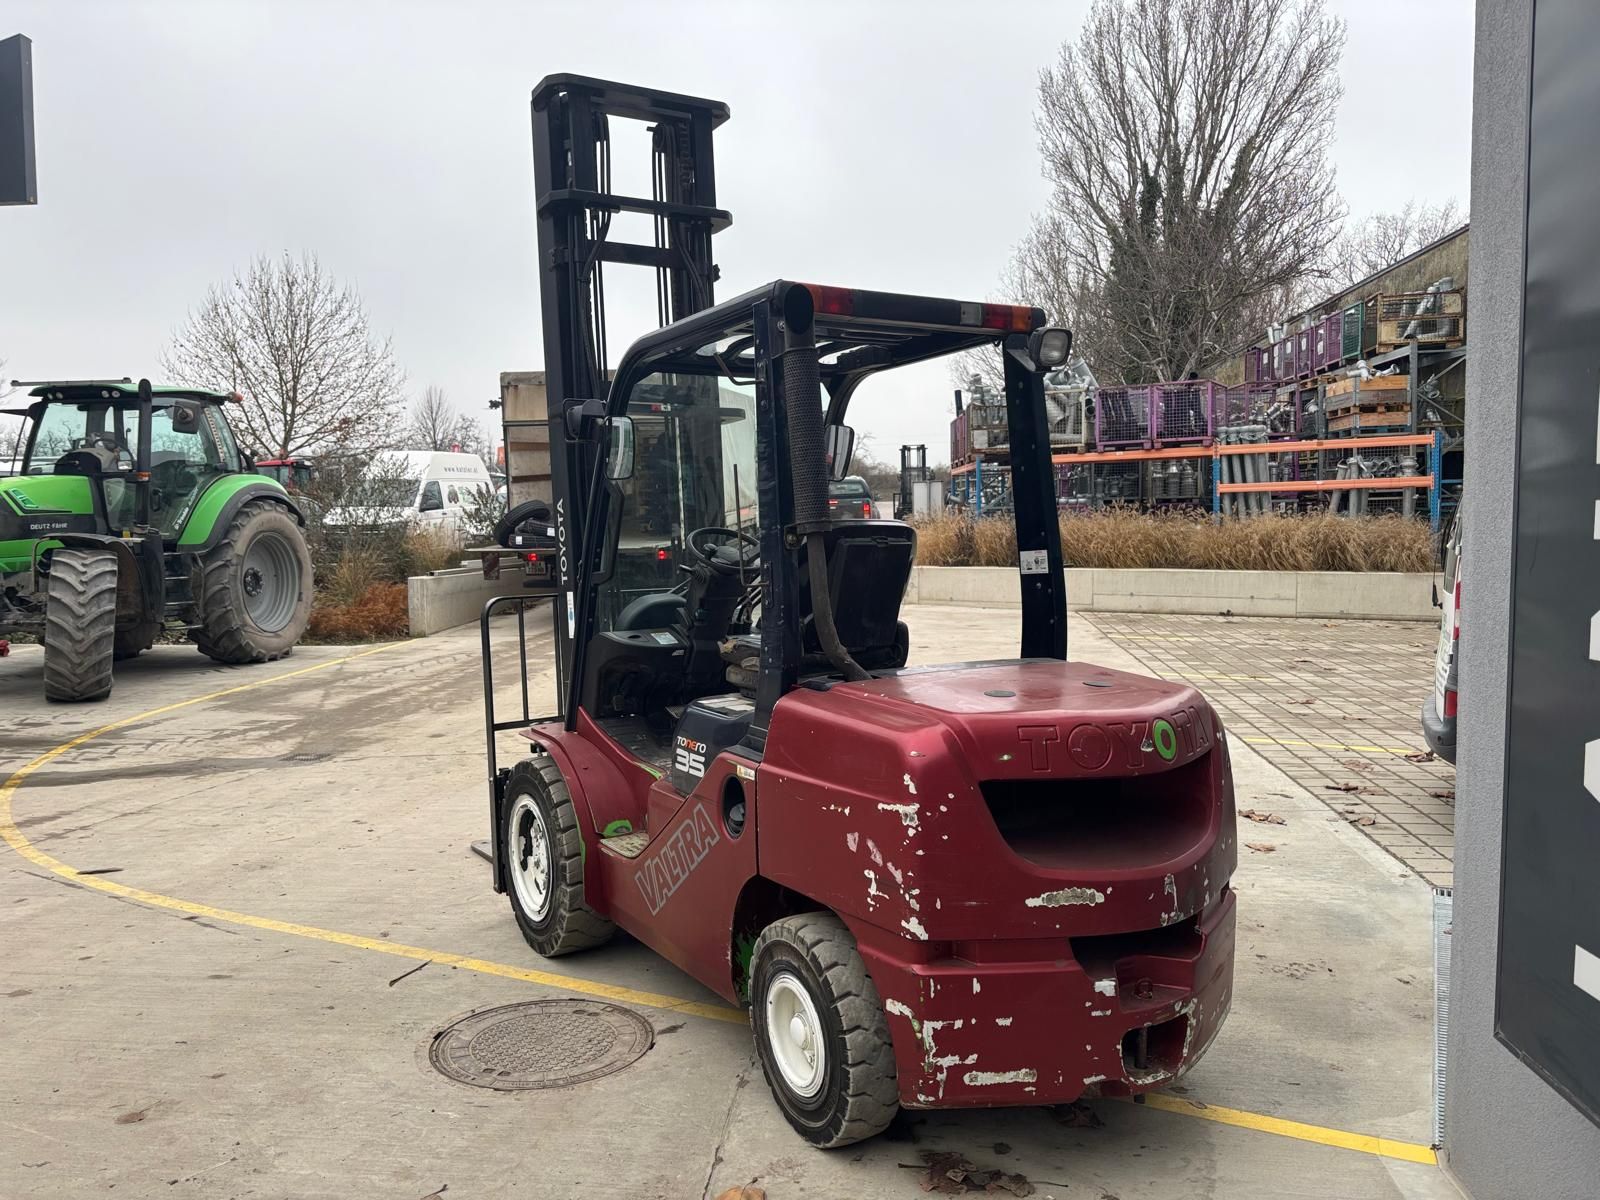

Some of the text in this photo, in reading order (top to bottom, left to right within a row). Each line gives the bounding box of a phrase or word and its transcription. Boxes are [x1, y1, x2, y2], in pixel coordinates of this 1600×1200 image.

[557, 498, 568, 585] TOYOTA
[675, 748, 705, 778] 35
[1017, 706, 1209, 772] TOYOTA
[634, 803, 720, 916] VALTRA
